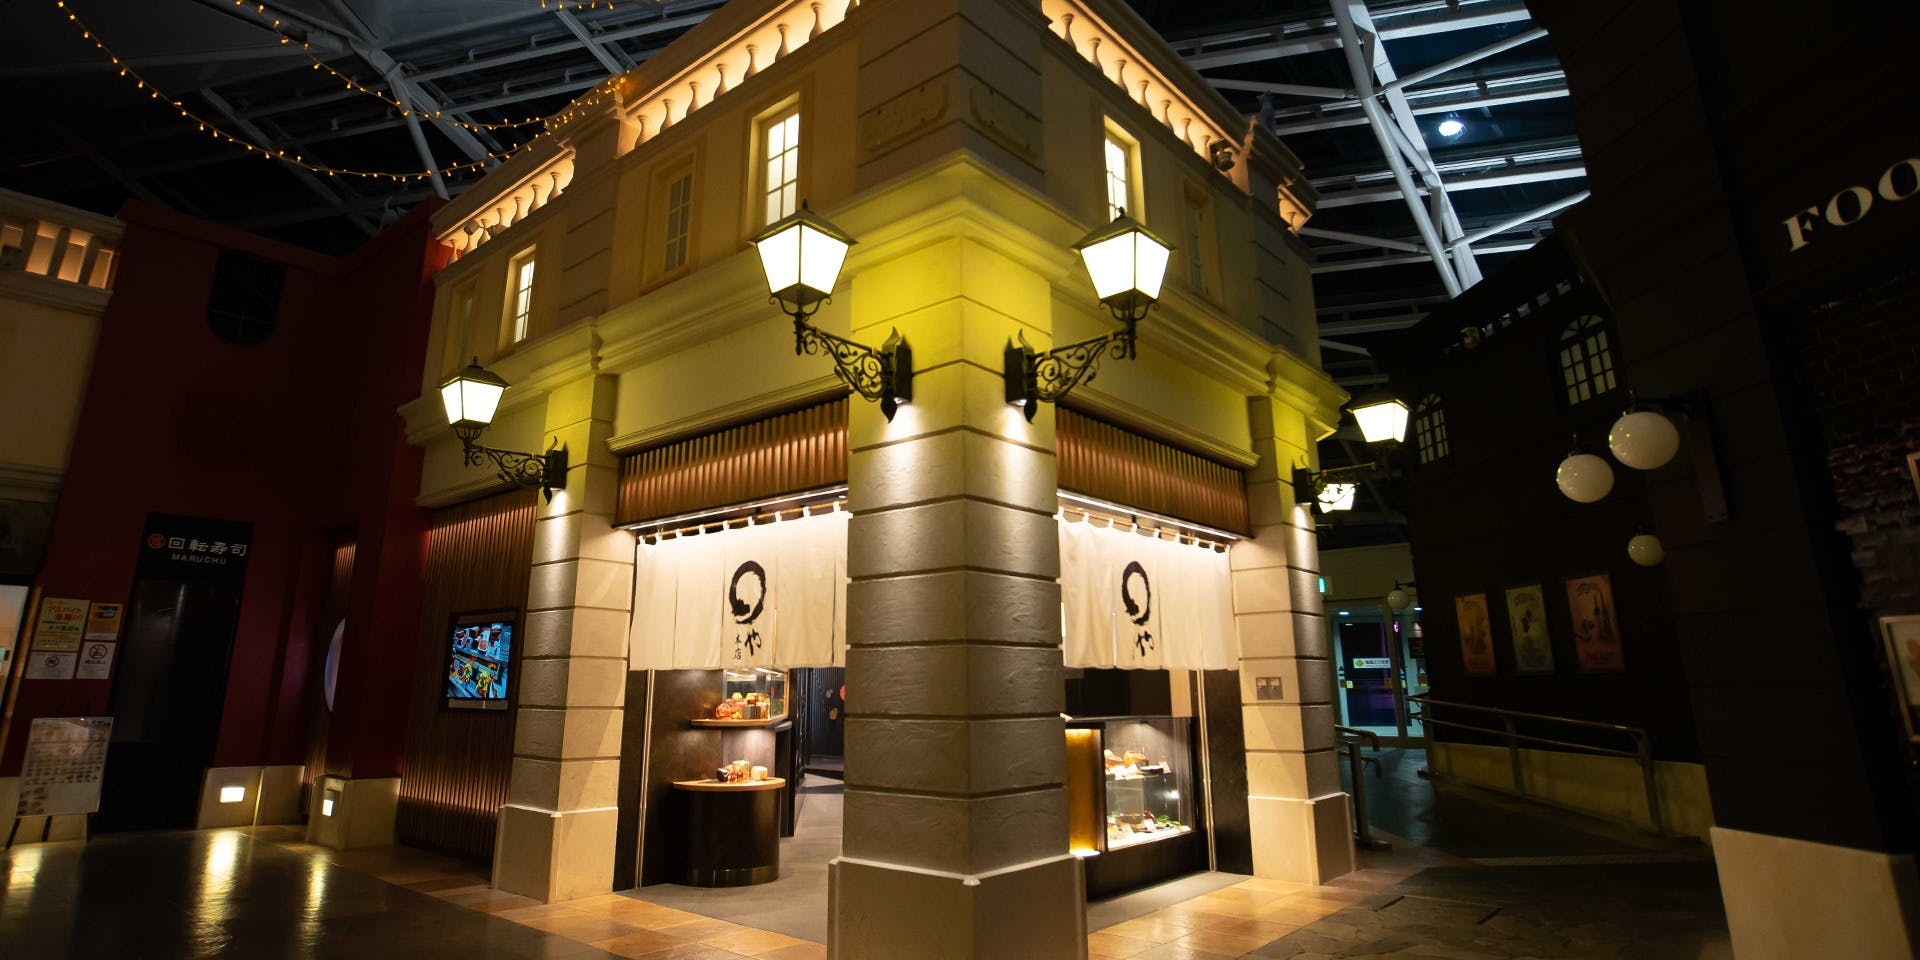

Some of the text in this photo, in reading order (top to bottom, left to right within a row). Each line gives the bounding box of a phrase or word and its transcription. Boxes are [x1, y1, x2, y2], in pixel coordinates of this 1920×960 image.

[1784, 158, 1920, 252] FOO
[168, 537, 247, 557] 回転寿司
[171, 554, 226, 565] MARUCHU
